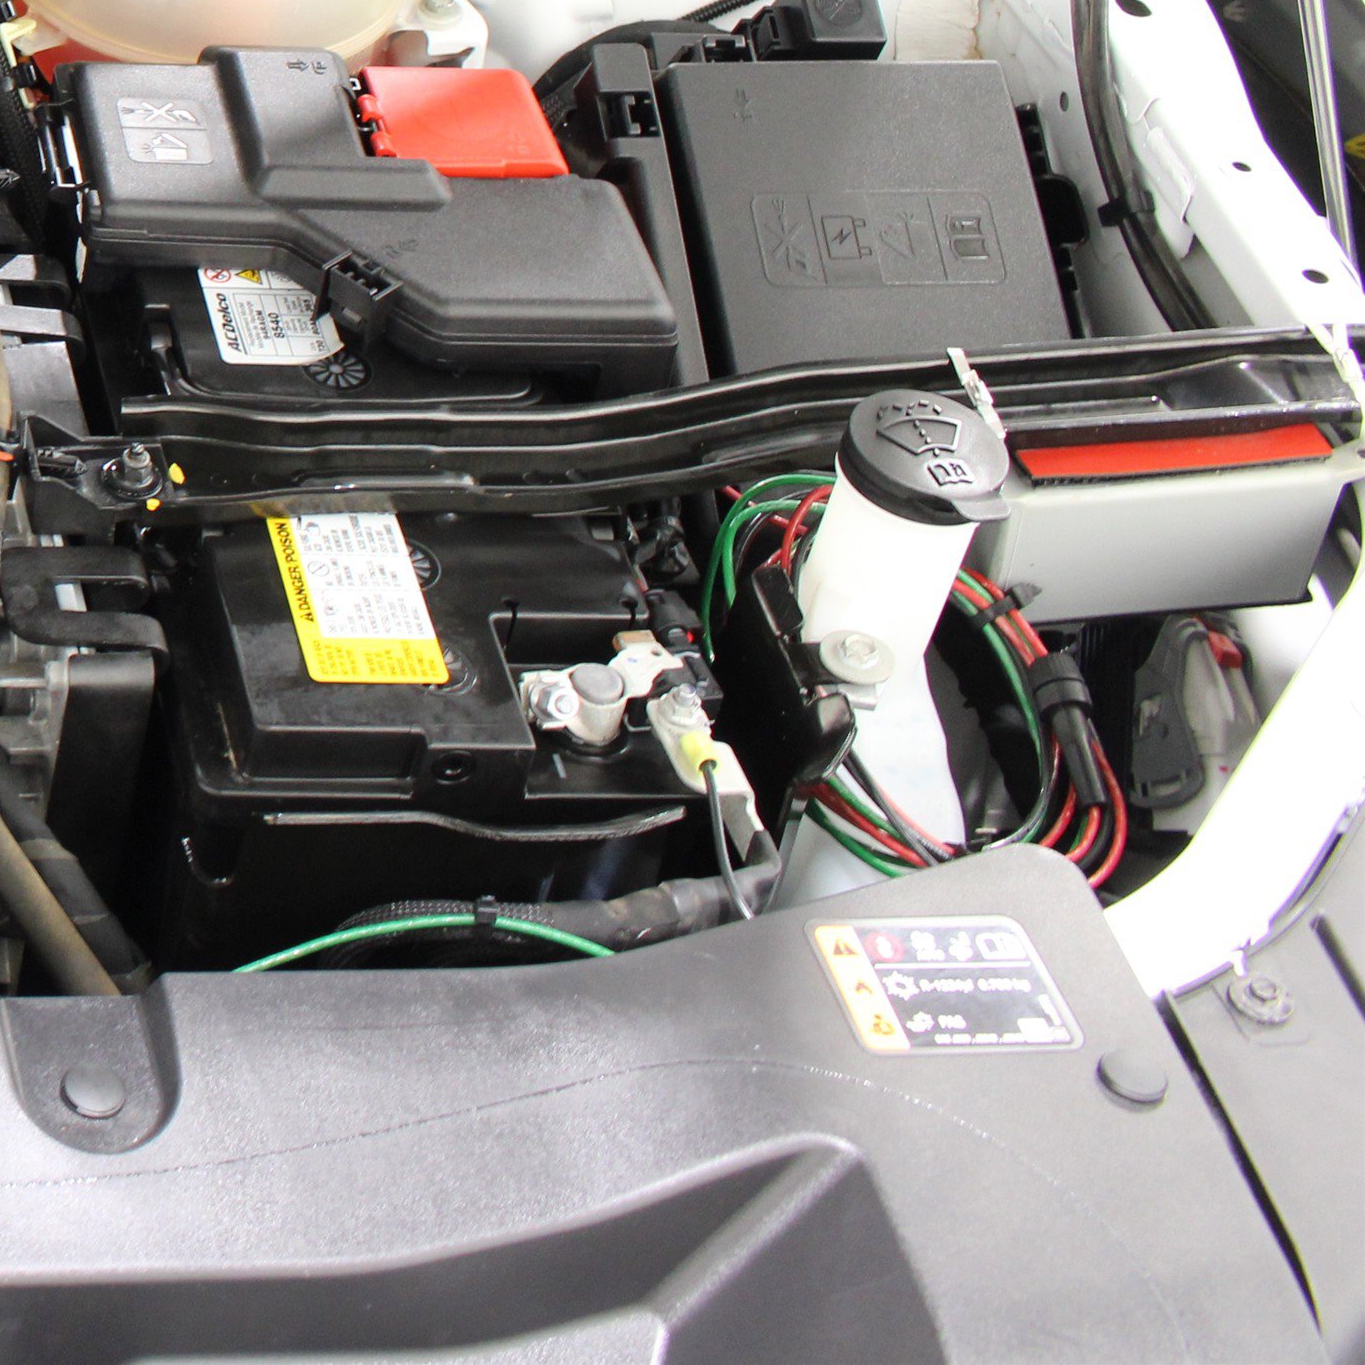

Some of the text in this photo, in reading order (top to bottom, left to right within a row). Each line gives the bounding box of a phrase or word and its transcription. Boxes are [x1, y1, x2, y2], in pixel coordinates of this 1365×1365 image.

[216, 292, 242, 352] ACDelco
[268, 312, 285, 339] 8540
[275, 522, 310, 614] DANGER POISON
